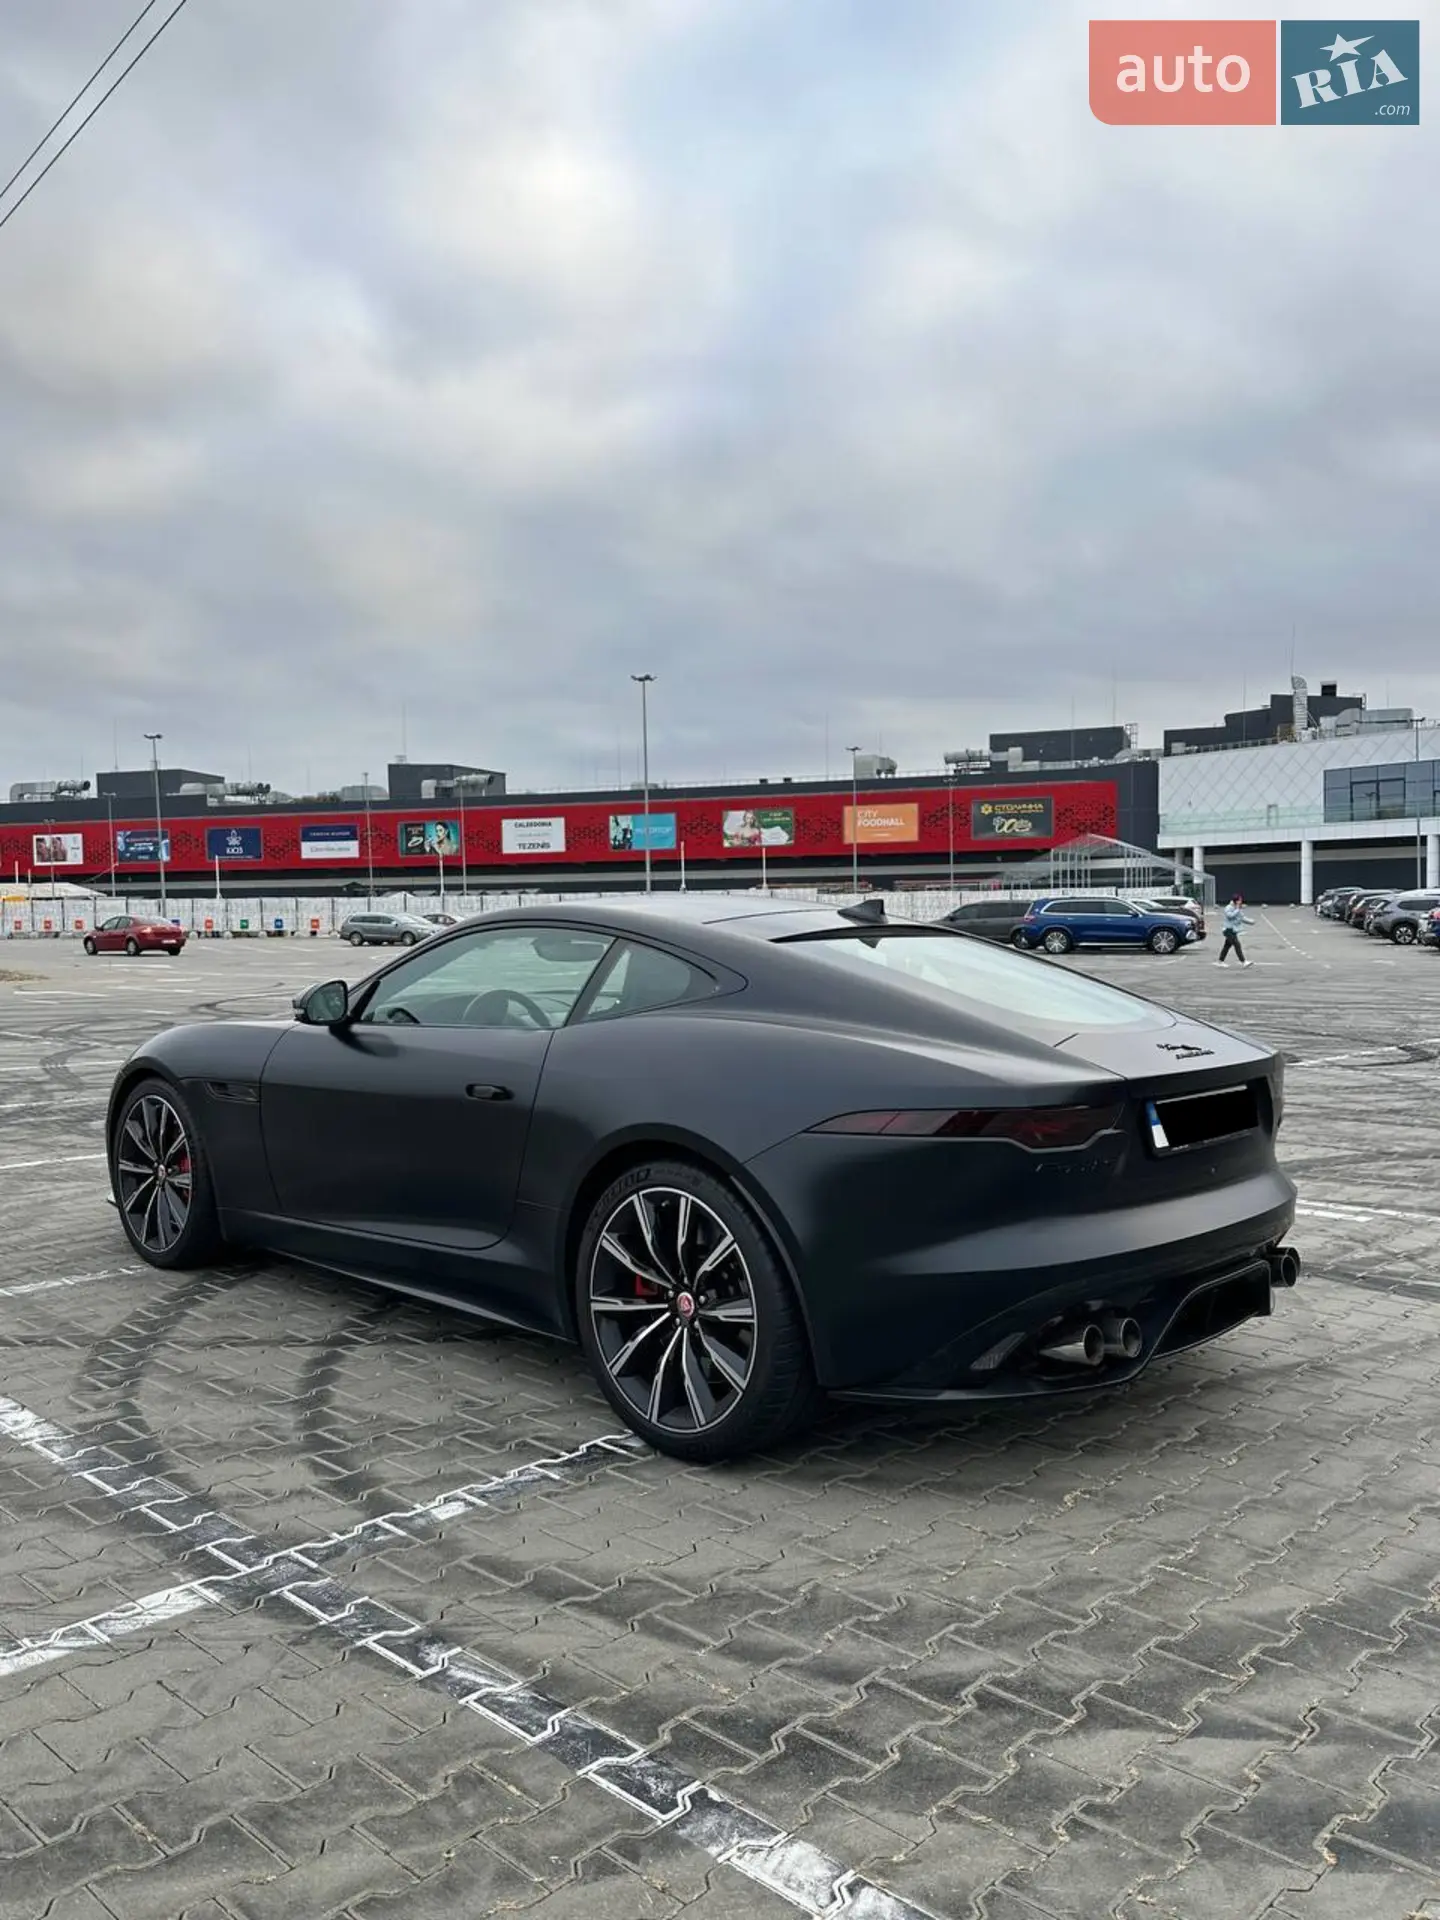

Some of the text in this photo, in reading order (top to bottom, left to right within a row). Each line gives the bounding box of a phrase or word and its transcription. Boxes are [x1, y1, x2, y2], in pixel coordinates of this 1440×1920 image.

[857, 808, 879, 818] CITY
[857, 817, 906, 828] FOODHALL
[516, 842, 551, 850] TEZENIS
